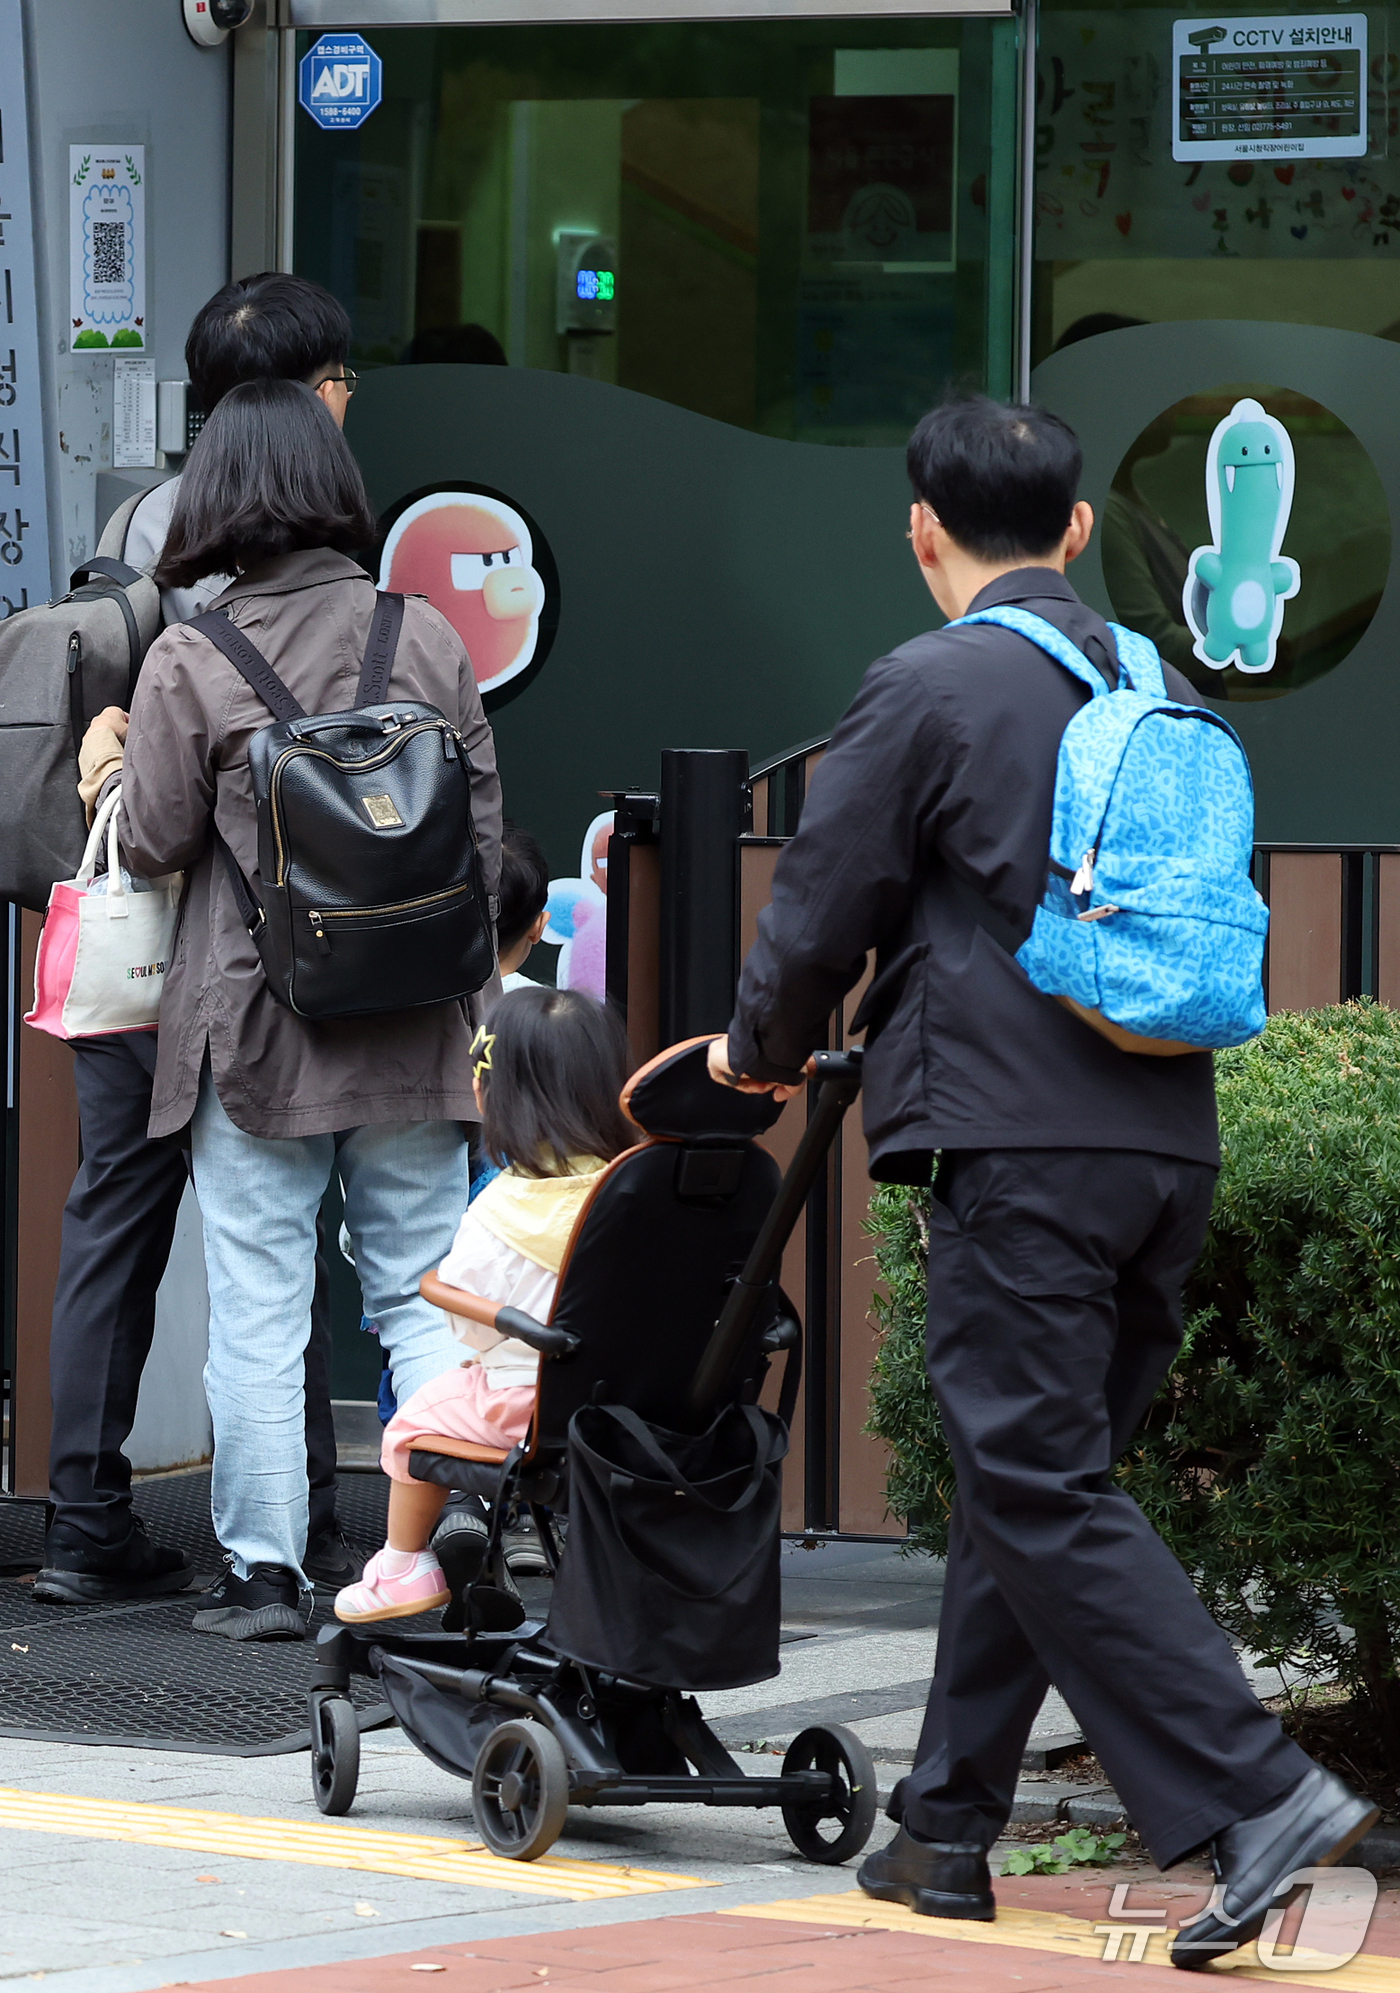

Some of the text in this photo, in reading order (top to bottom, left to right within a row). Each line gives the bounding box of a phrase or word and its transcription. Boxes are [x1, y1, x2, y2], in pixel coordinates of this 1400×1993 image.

[1233, 26, 1353, 46] CCTV 설치안내
[317, 45, 364, 55] 캡스경비구역
[311, 64, 369, 97] ADT
